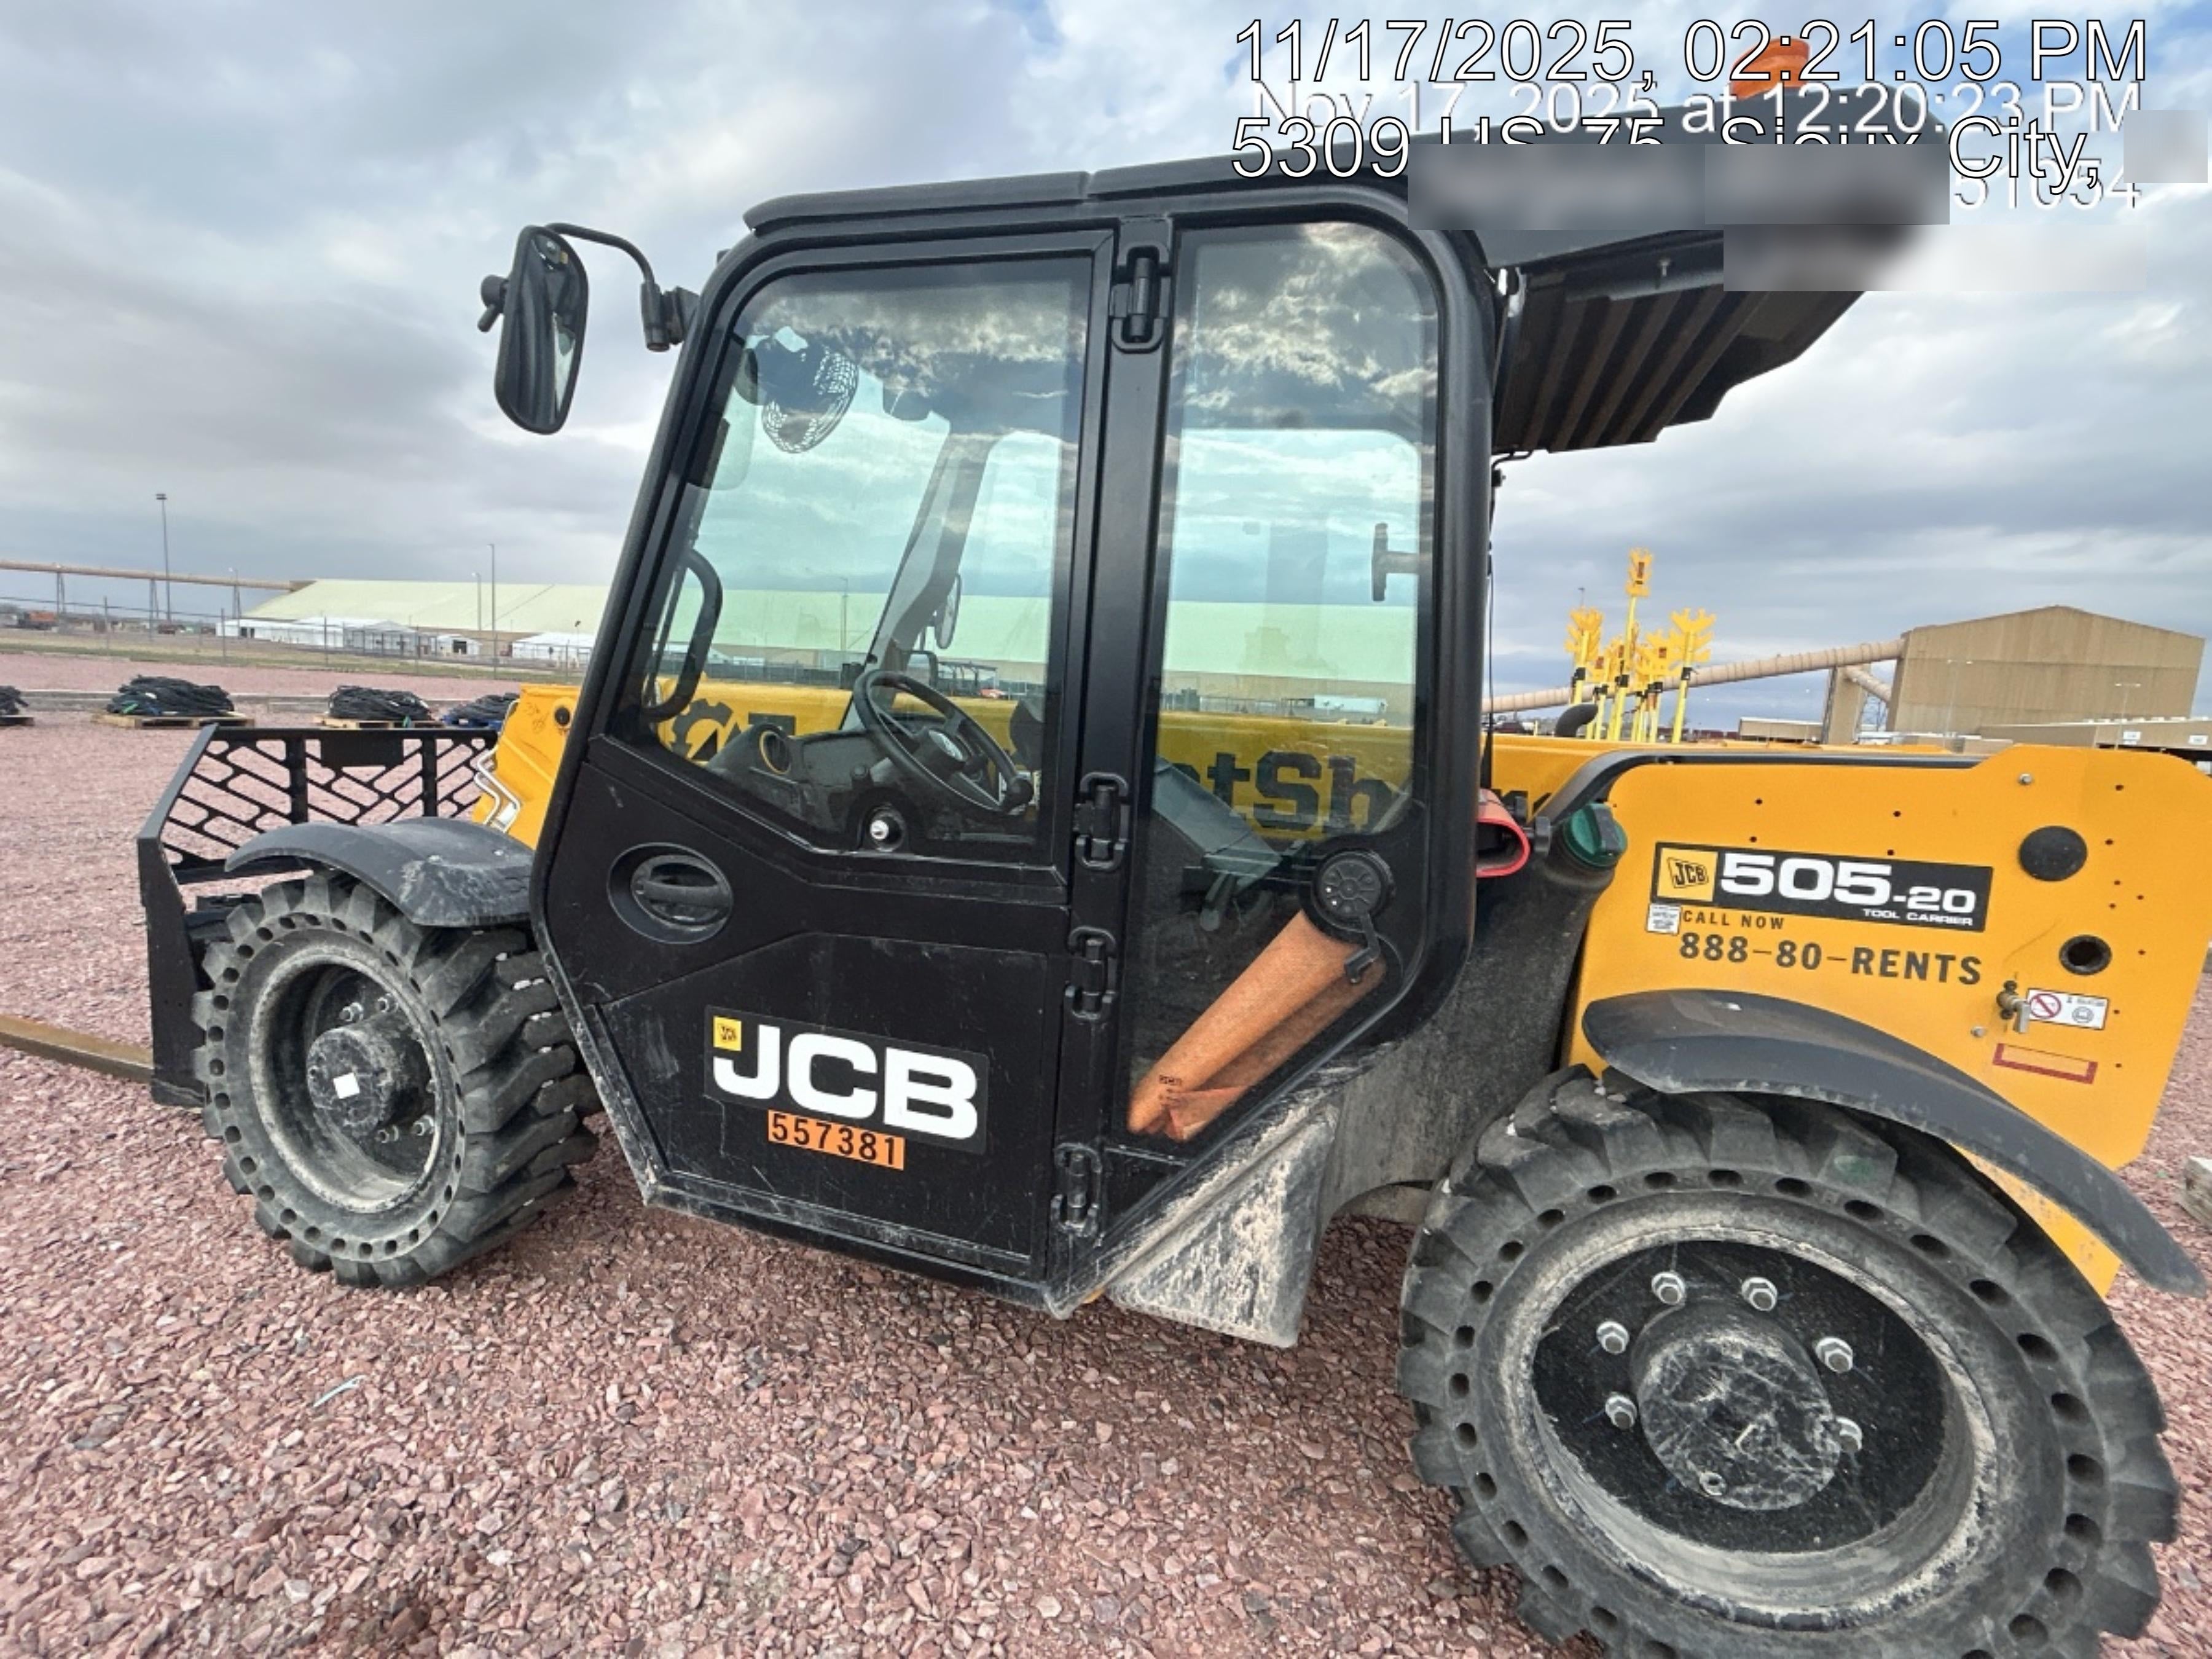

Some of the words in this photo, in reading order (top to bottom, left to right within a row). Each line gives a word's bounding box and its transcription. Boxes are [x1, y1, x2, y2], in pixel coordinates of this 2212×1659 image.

[1674, 861, 1707, 885] JCB
[1720, 852, 1976, 913] 505-20
[1682, 910, 1730, 925] CALL
[1741, 914, 1784, 930] NOW
[1863, 908, 1900, 919] TOOL
[1907, 912, 1973, 926] CARRIER
[1680, 932, 1982, 984] 888-80-RENTS
[713, 1024, 978, 1139] JCB
[772, 1114, 895, 1165] 557381
